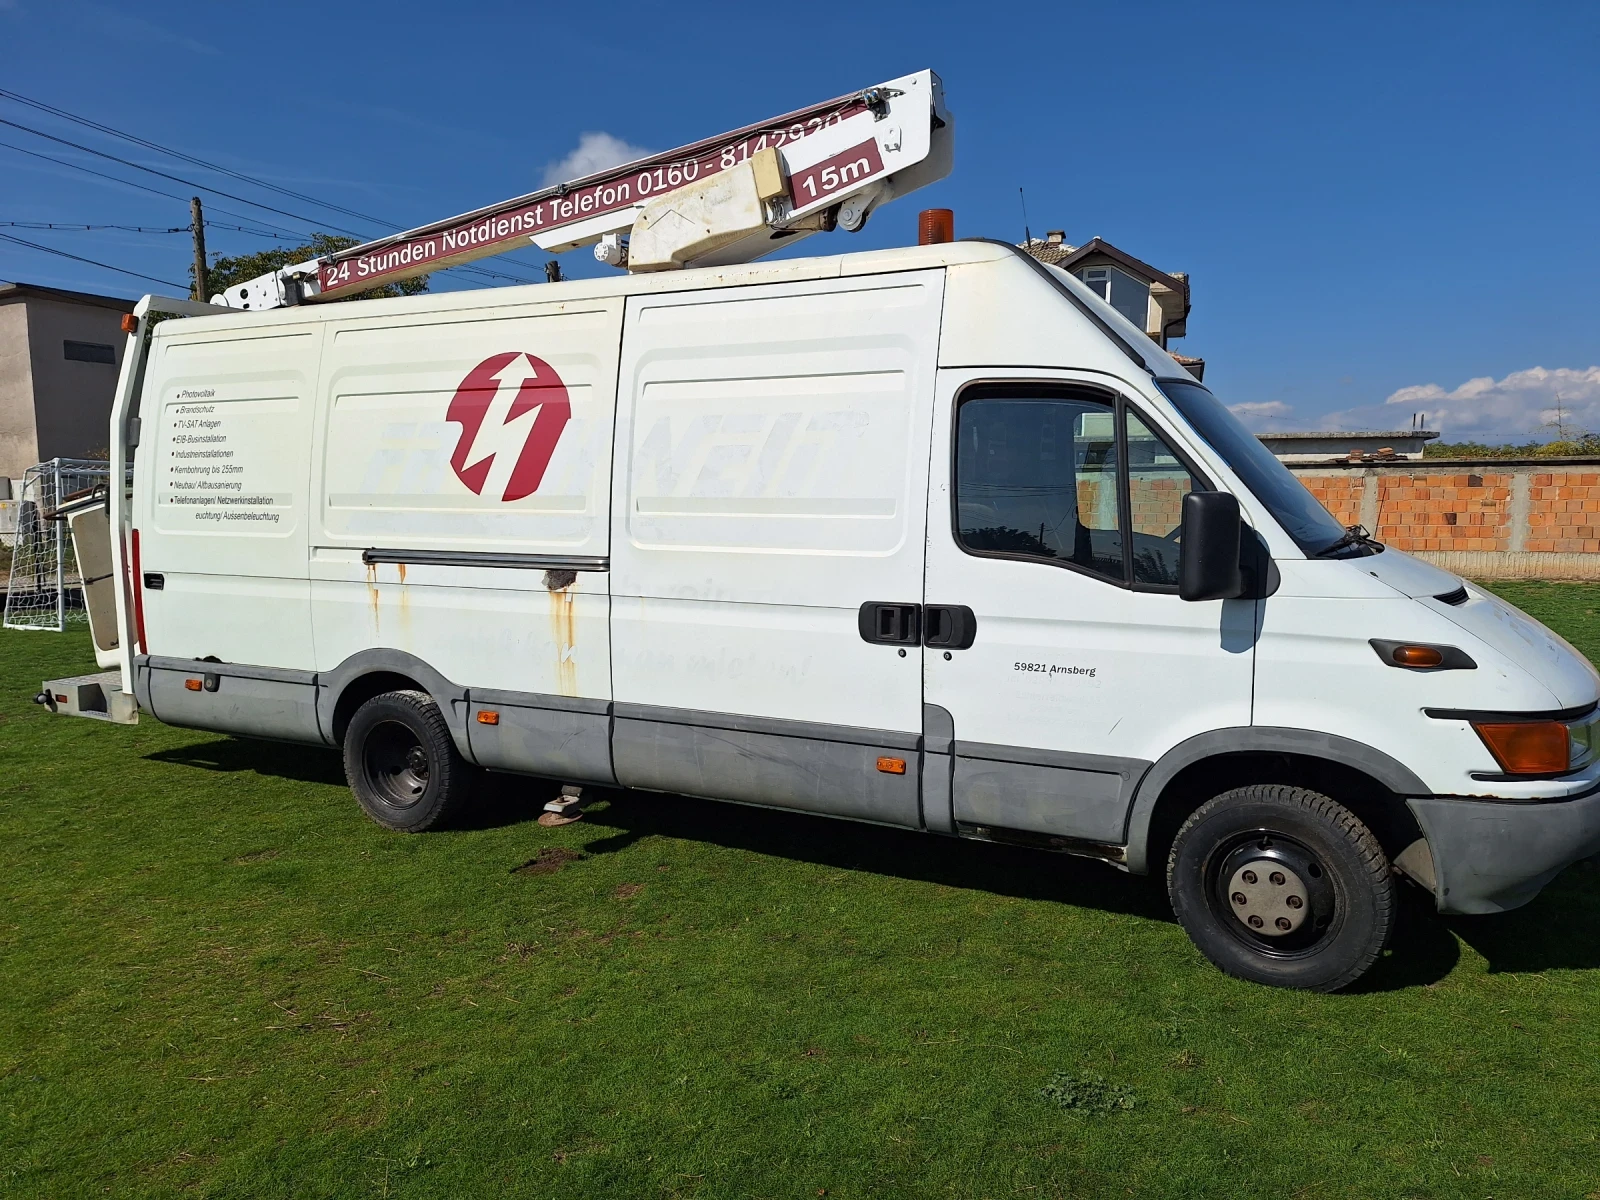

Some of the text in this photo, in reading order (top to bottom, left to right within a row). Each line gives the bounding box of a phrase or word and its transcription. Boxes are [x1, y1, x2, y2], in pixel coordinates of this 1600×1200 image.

[802, 157, 871, 198] 15m
[326, 262, 350, 287] 24
[356, 240, 436, 277] Stunden
[441, 204, 544, 253] Notdienst
[550, 182, 630, 221] Telefon
[637, 159, 699, 195] 0160
[181, 389, 216, 398] Photovoltaik
[180, 405, 215, 414] Brandschutz
[178, 419, 221, 430] TV-SAT Anlagen
[211, 465, 221, 474] bis
[221, 464, 244, 474] 255mm
[197, 480, 242, 492] Altbausanierung
[216, 496, 274, 505] Netzwerkinstallation
[1013, 661, 1097, 678] 59821 Arnsberg
